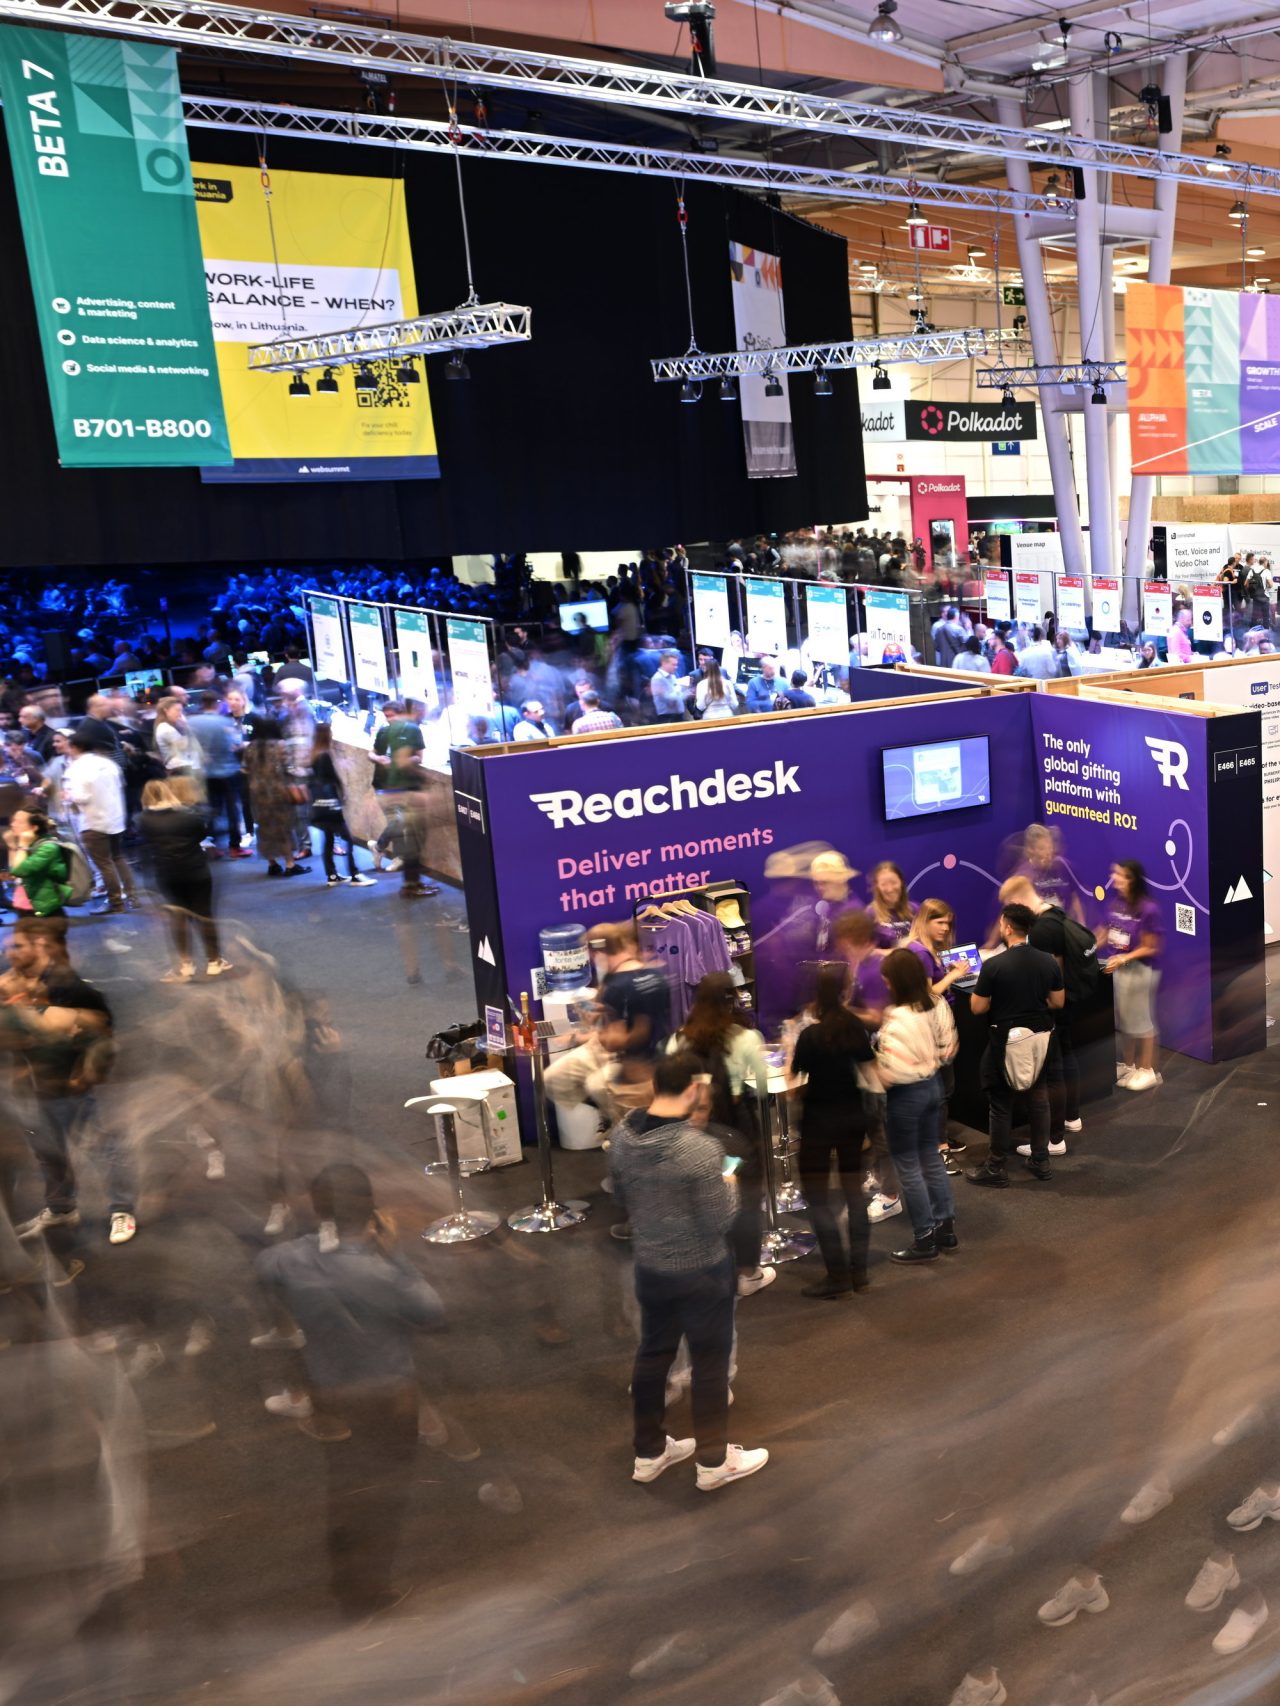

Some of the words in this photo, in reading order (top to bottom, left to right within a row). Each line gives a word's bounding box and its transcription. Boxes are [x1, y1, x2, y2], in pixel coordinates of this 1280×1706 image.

[21, 58, 55, 81] 7
[27, 90, 70, 178] BETA
[76, 297, 136, 309] Advertising,
[137, 301, 175, 310] content
[324, 297, 395, 311] WHEN?
[78, 308, 86, 316] &
[87, 309, 138, 320] marketing
[211, 322, 234, 331] ow,
[236, 321, 247, 329] in
[250, 321, 308, 332] Lithuania.
[82, 335, 106, 344] Data
[107, 336, 145, 346] science
[146, 337, 154, 346] &
[155, 337, 199, 349] analytics
[86, 364, 117, 373] Social
[117, 365, 147, 374] media
[148, 366, 156, 374] &
[156, 366, 209, 377] networking
[1246, 366, 1280, 376] GROWTH
[1191, 389, 1213, 398] BETA
[947, 410, 1023, 432] Polkadot
[1137, 413, 1168, 423] ALPHA
[1253, 417, 1279, 433] SCALE
[73, 418, 212, 438] B701-B800
[928, 482, 961, 493] Polkadot
[1033, 541, 1046, 549] map
[1191, 547, 1208, 555] Voice
[1209, 546, 1221, 554] and
[1175, 560, 1193, 568] Video
[1194, 558, 1209, 567] Chat
[1252, 684, 1267, 693] User
[1043, 733, 1063, 750] The
[1066, 740, 1091, 756] only
[1043, 755, 1079, 774] global
[1082, 765, 1121, 786] gifting
[1217, 761, 1235, 771] E466
[1239, 757, 1256, 767] E465
[529, 760, 802, 829] Reachdesk
[1044, 778, 1093, 800] platform
[1095, 788, 1121, 804] with
[1045, 800, 1110, 824] guaranteed
[1113, 813, 1138, 831] ROI
[557, 846, 652, 880] Deliver
[660, 826, 775, 863] moments
[559, 884, 620, 912] that
[625, 868, 711, 900] matter
